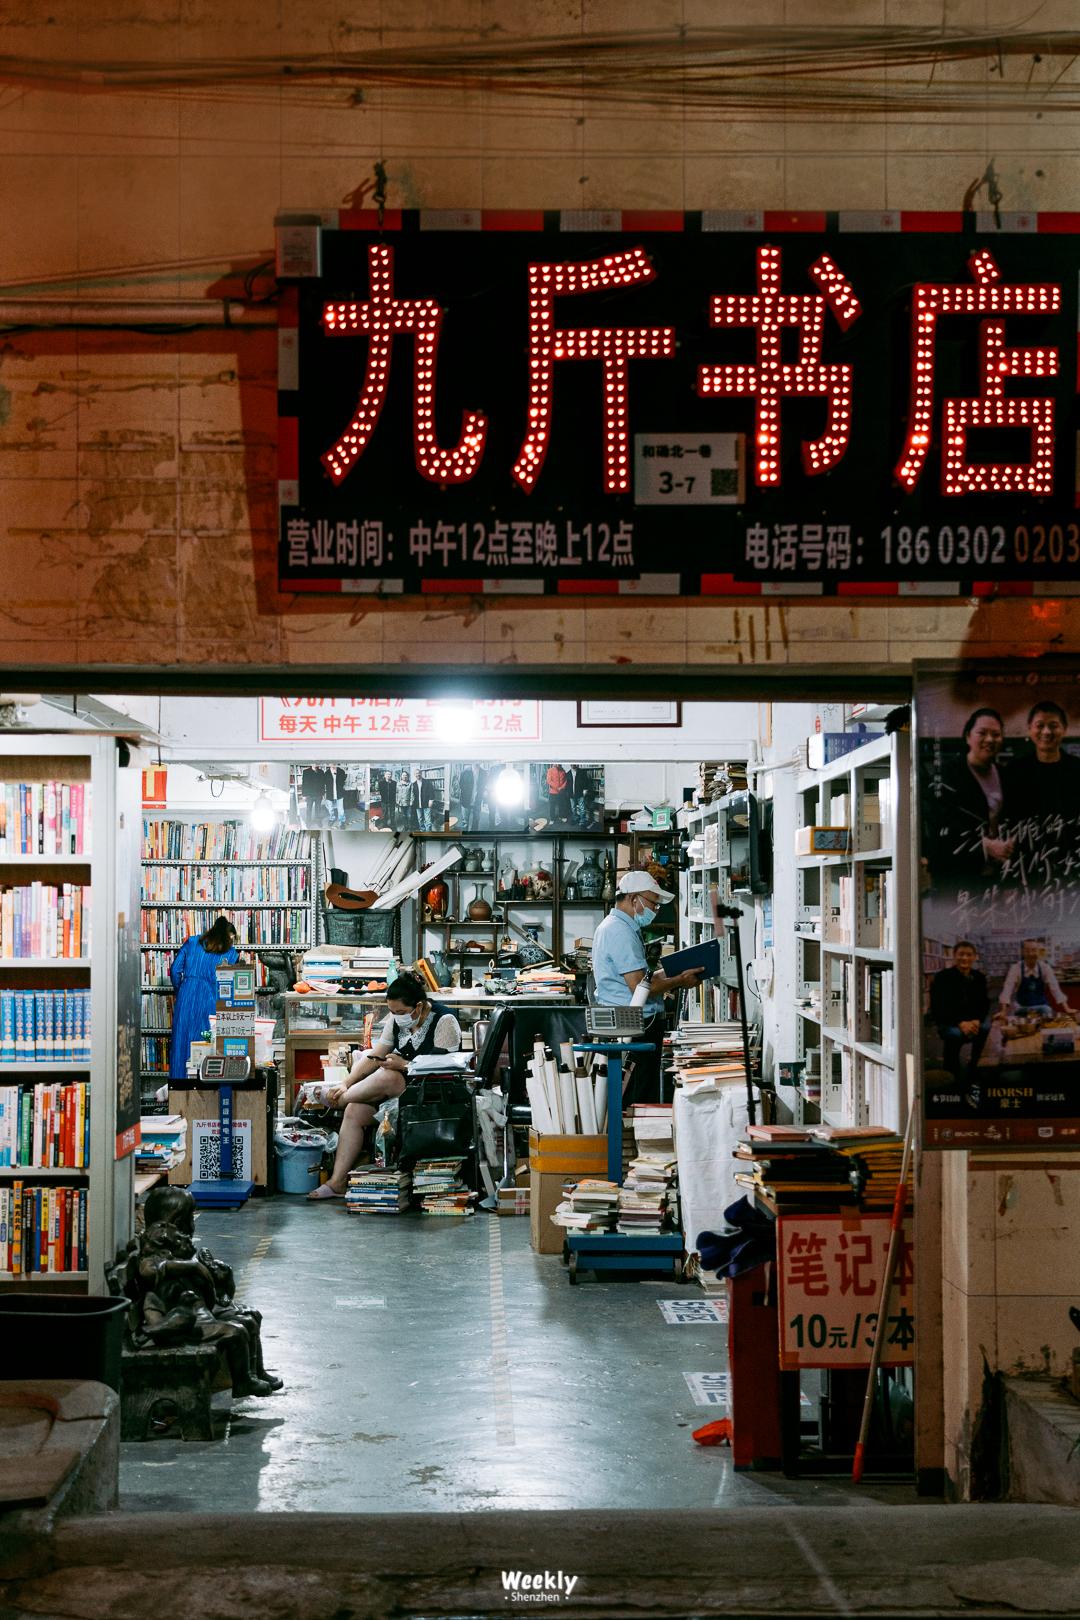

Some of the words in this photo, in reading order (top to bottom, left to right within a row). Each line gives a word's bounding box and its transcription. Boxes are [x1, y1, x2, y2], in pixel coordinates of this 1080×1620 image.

[320, 243, 1062, 497] 九斤书店
[659, 470, 696, 494] 3-7
[938, 525, 1006, 566] 0302
[1014, 524, 1079, 564] 0203
[787, 1232, 914, 1297] 笔记本
